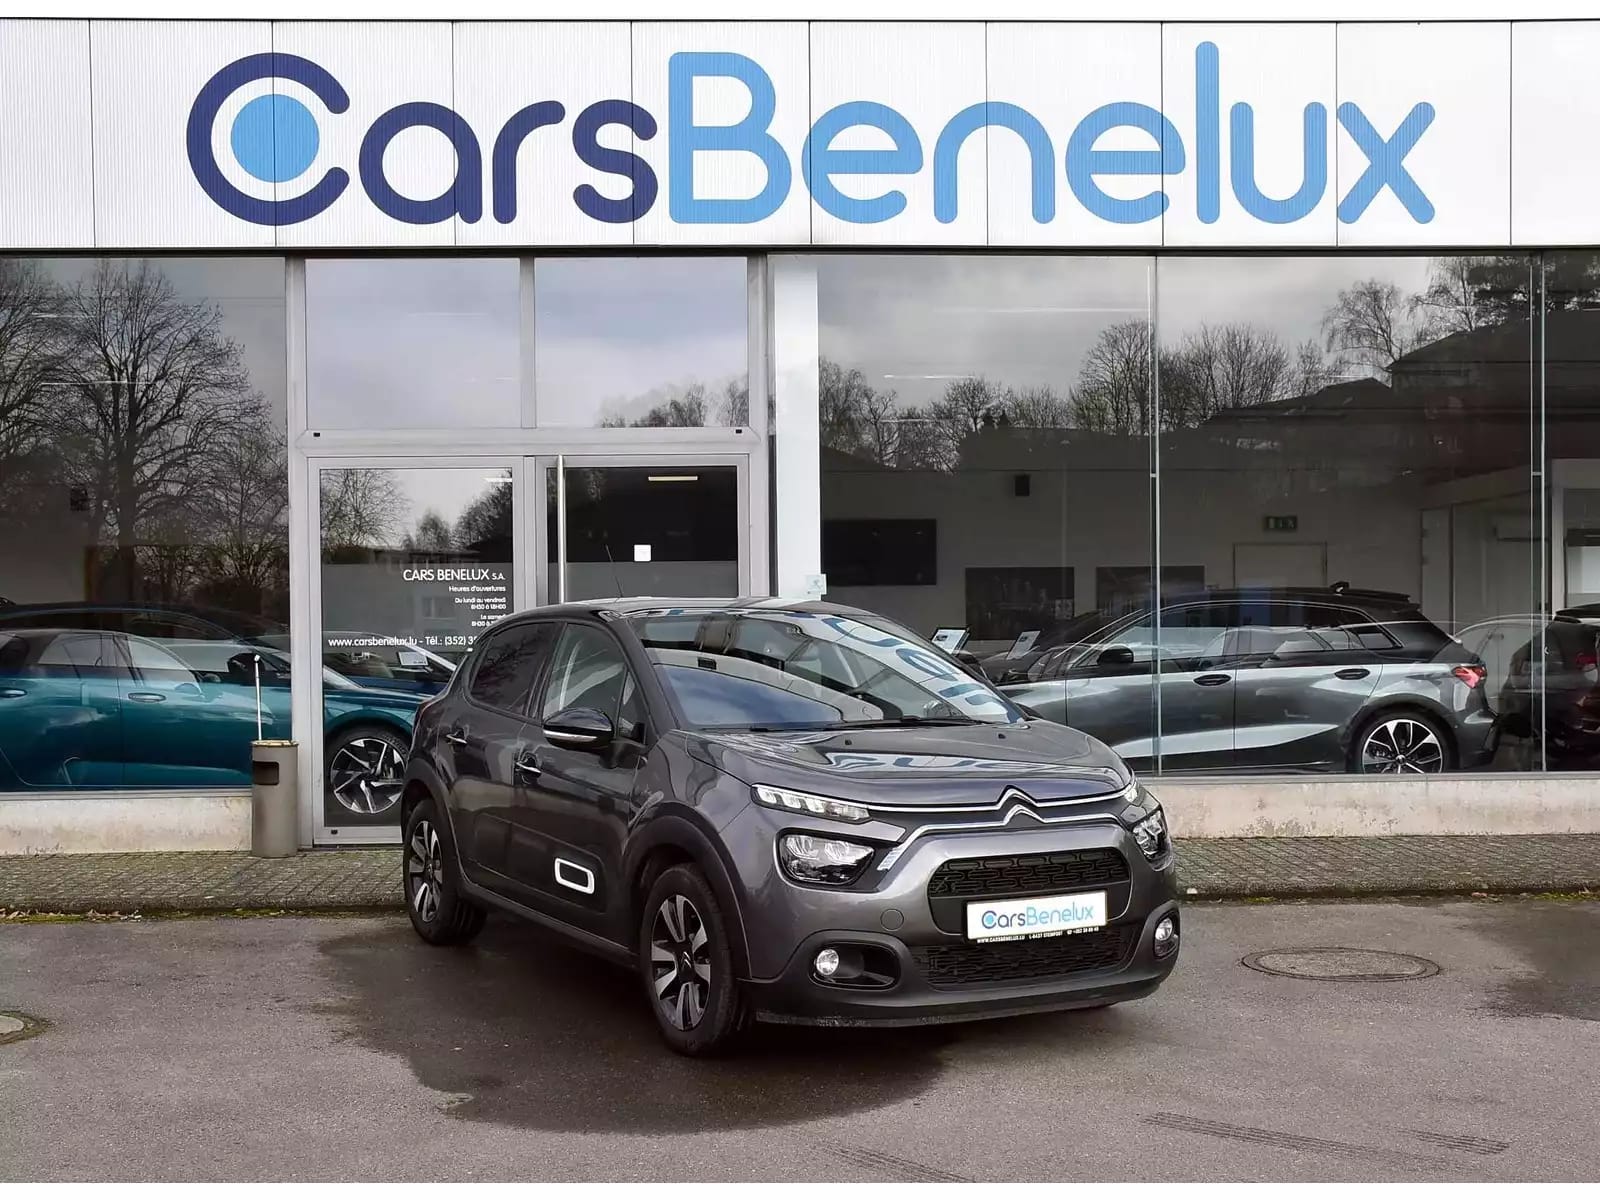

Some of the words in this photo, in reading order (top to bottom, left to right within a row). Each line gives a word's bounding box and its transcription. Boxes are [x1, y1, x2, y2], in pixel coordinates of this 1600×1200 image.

[186, 41, 1436, 226] CarsBenelux
[402, 569, 434, 581] CARS
[437, 568, 490, 581] BENELUX
[328, 636, 418, 648] www.carsbenelux.lu
[444, 635, 466, 647] (352)
[981, 902, 1094, 930] CarsBenelux
